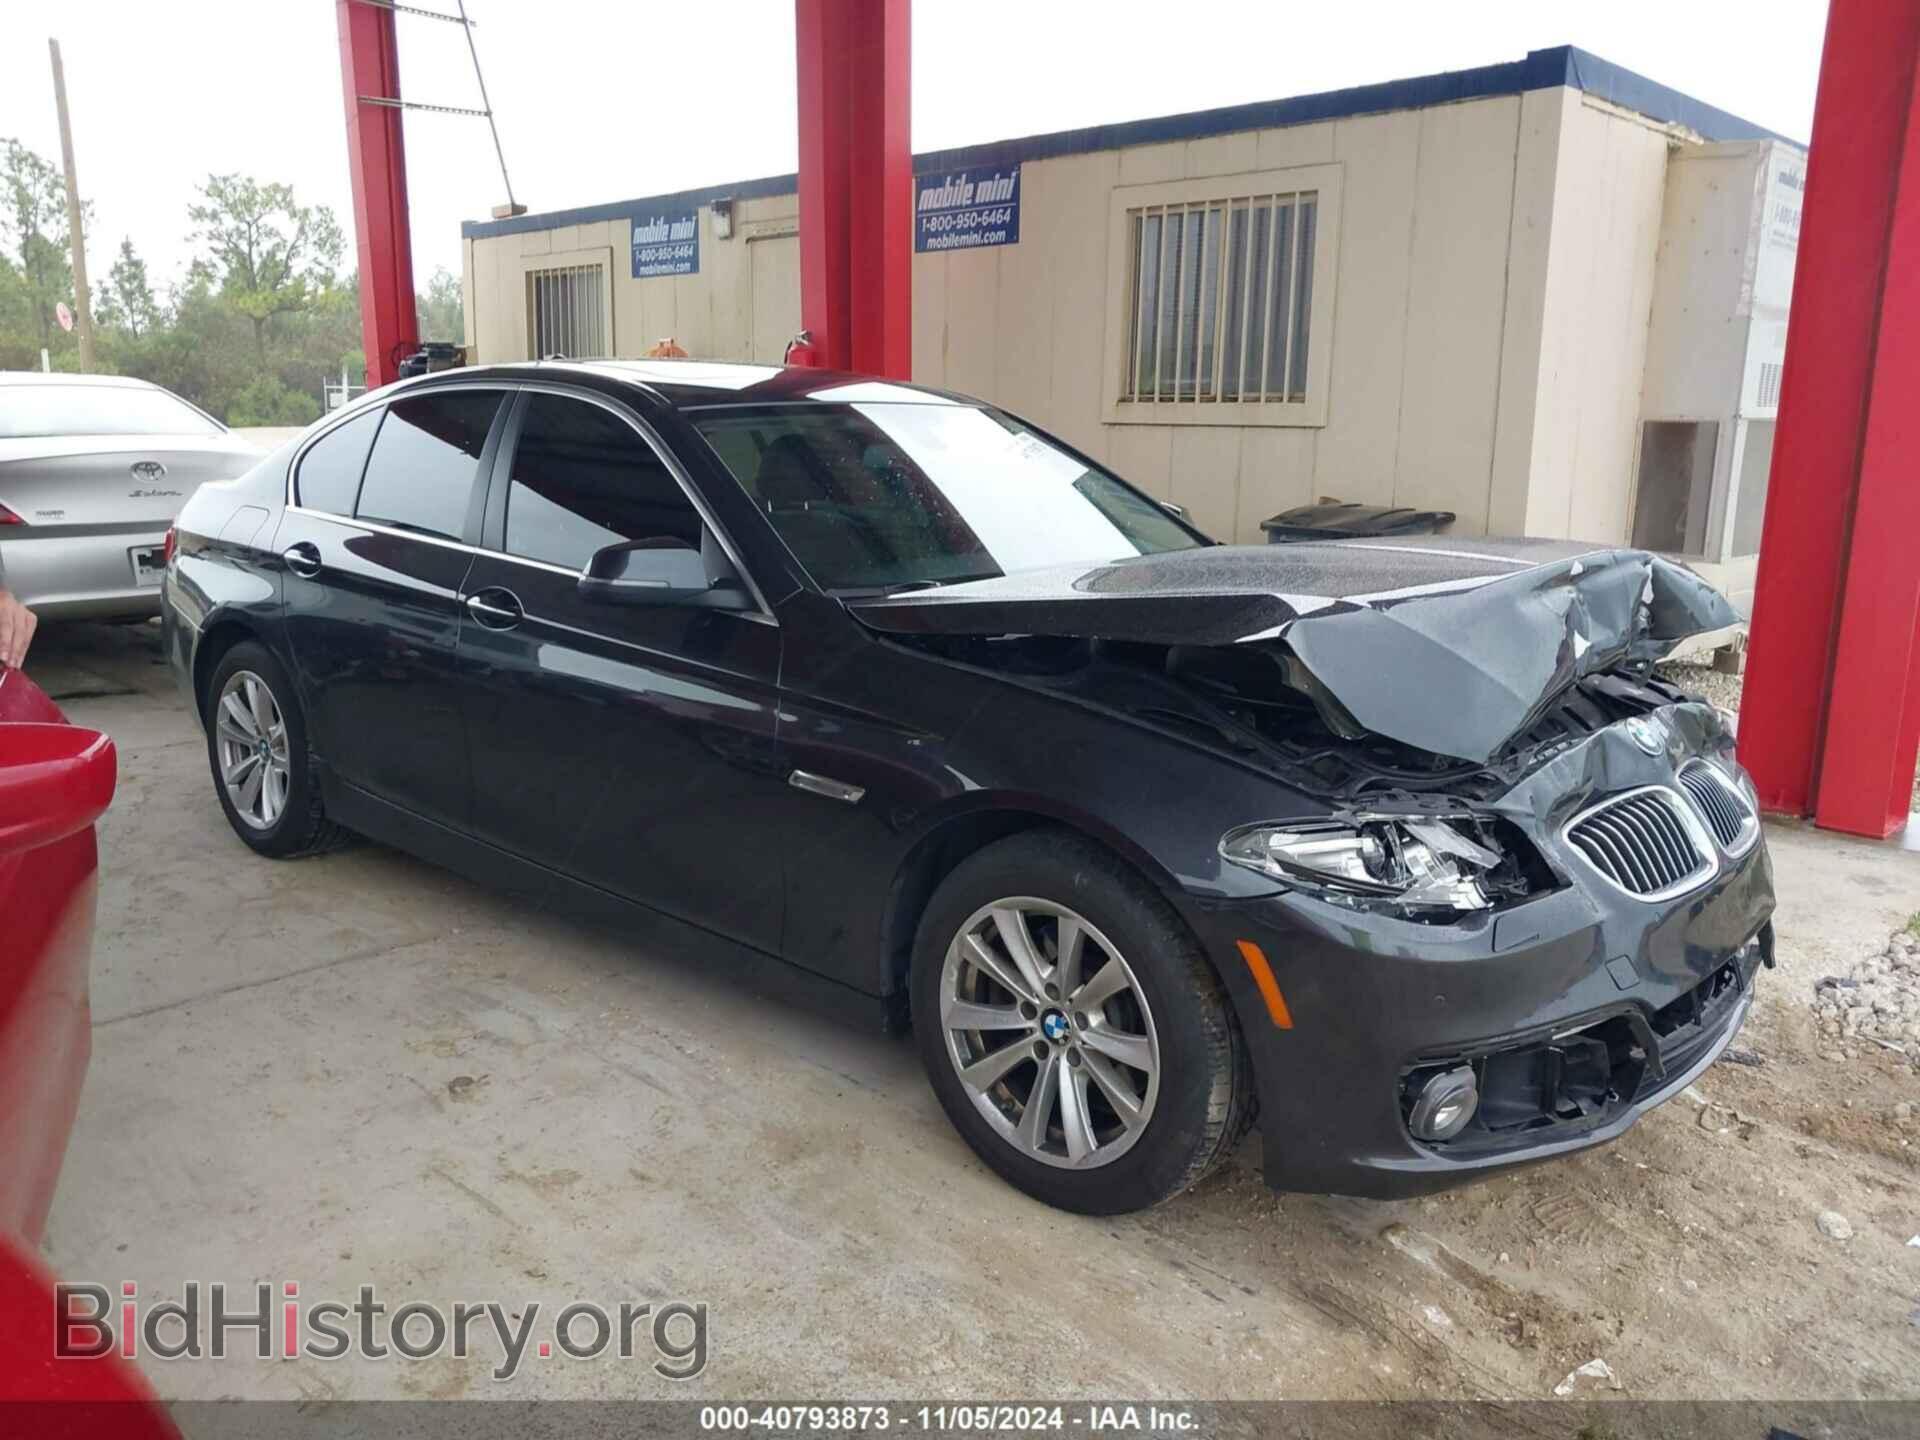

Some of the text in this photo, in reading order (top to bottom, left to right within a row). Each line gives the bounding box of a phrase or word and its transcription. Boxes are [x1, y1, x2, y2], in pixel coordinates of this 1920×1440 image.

[918, 171, 1017, 211] mobile mini
[633, 216, 696, 244] mobile mini
[922, 207, 1011, 232] 1-800-950-6464
[927, 230, 1006, 249] mobilemini.com
[636, 245, 693, 262] 1-800-950-6464
[640, 262, 691, 275] mobilemini.com
